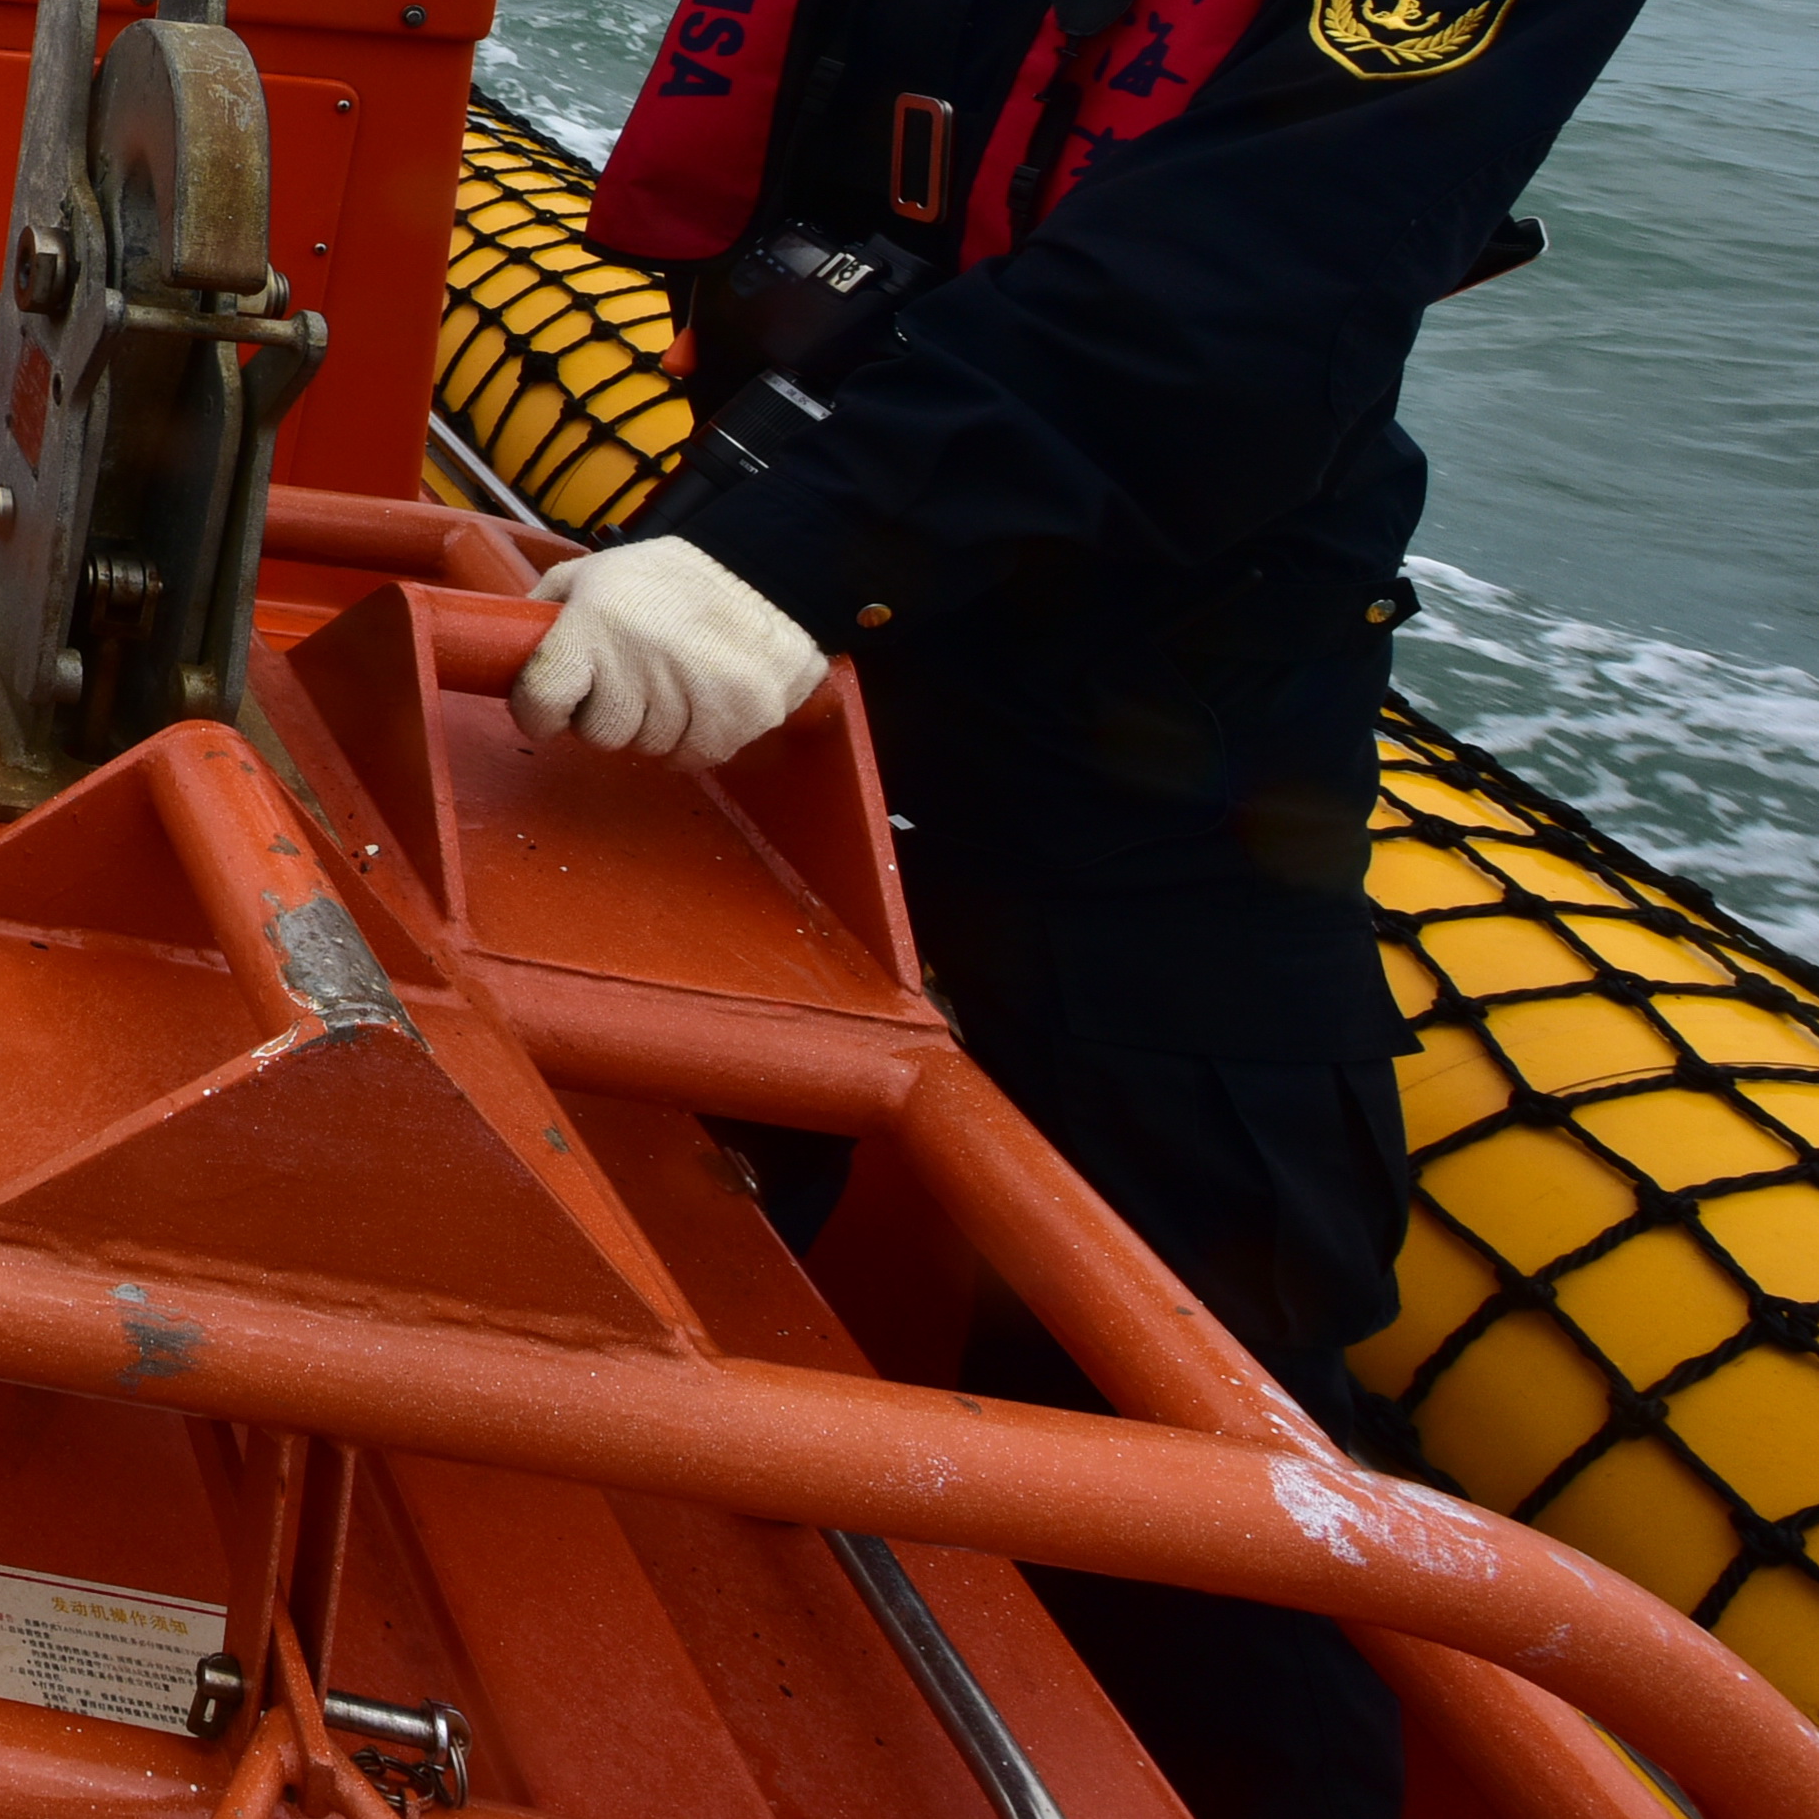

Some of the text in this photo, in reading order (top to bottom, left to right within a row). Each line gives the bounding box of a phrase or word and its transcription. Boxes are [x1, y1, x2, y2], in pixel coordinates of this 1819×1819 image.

[51, 1596, 189, 1636] 发动机操作须知
